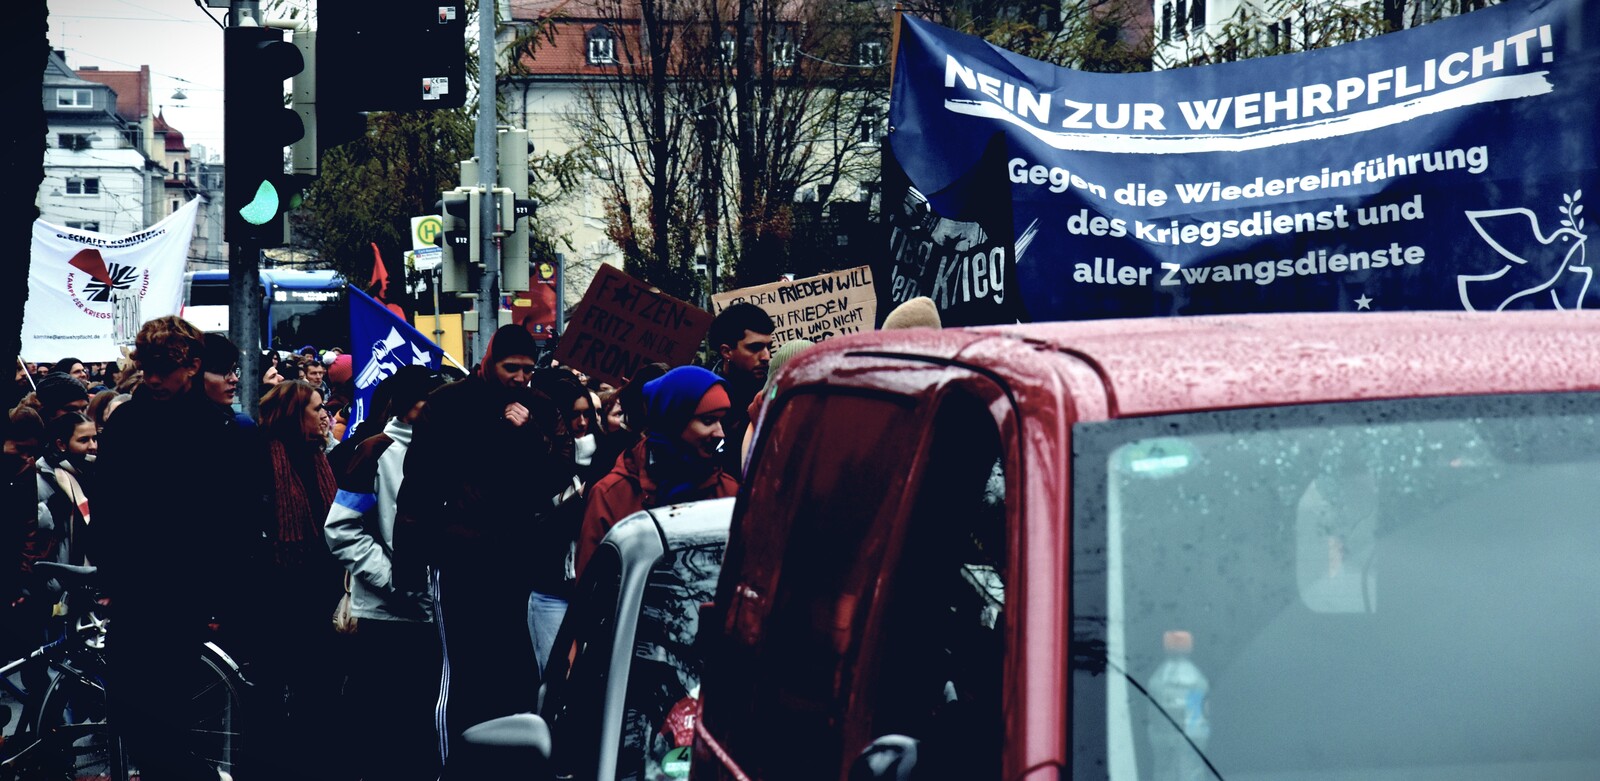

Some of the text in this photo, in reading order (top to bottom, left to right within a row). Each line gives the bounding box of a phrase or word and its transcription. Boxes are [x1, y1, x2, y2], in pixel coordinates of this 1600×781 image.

[945, 24, 1553, 130] NEIN ZUR WEHRPFLICHT!
[1008, 146, 1488, 206] Gegen die Wiedereinführung
[1067, 194, 1424, 247] des Kriegsdienst und
[1073, 243, 1425, 286] aller Zwangsdienste
[67, 272, 75, 298] KAMPF
[73, 297, 84, 309] DER
[750, 292, 776, 306] DEN
[778, 277, 833, 304] FRIEDEN
[836, 267, 872, 290] WILL
[582, 304, 635, 343] FRITZ
[787, 296, 848, 326] FRIEDEN
[808, 320, 831, 335] UND
[832, 307, 864, 329] NICHT
[677, 747, 689, 761] 4
